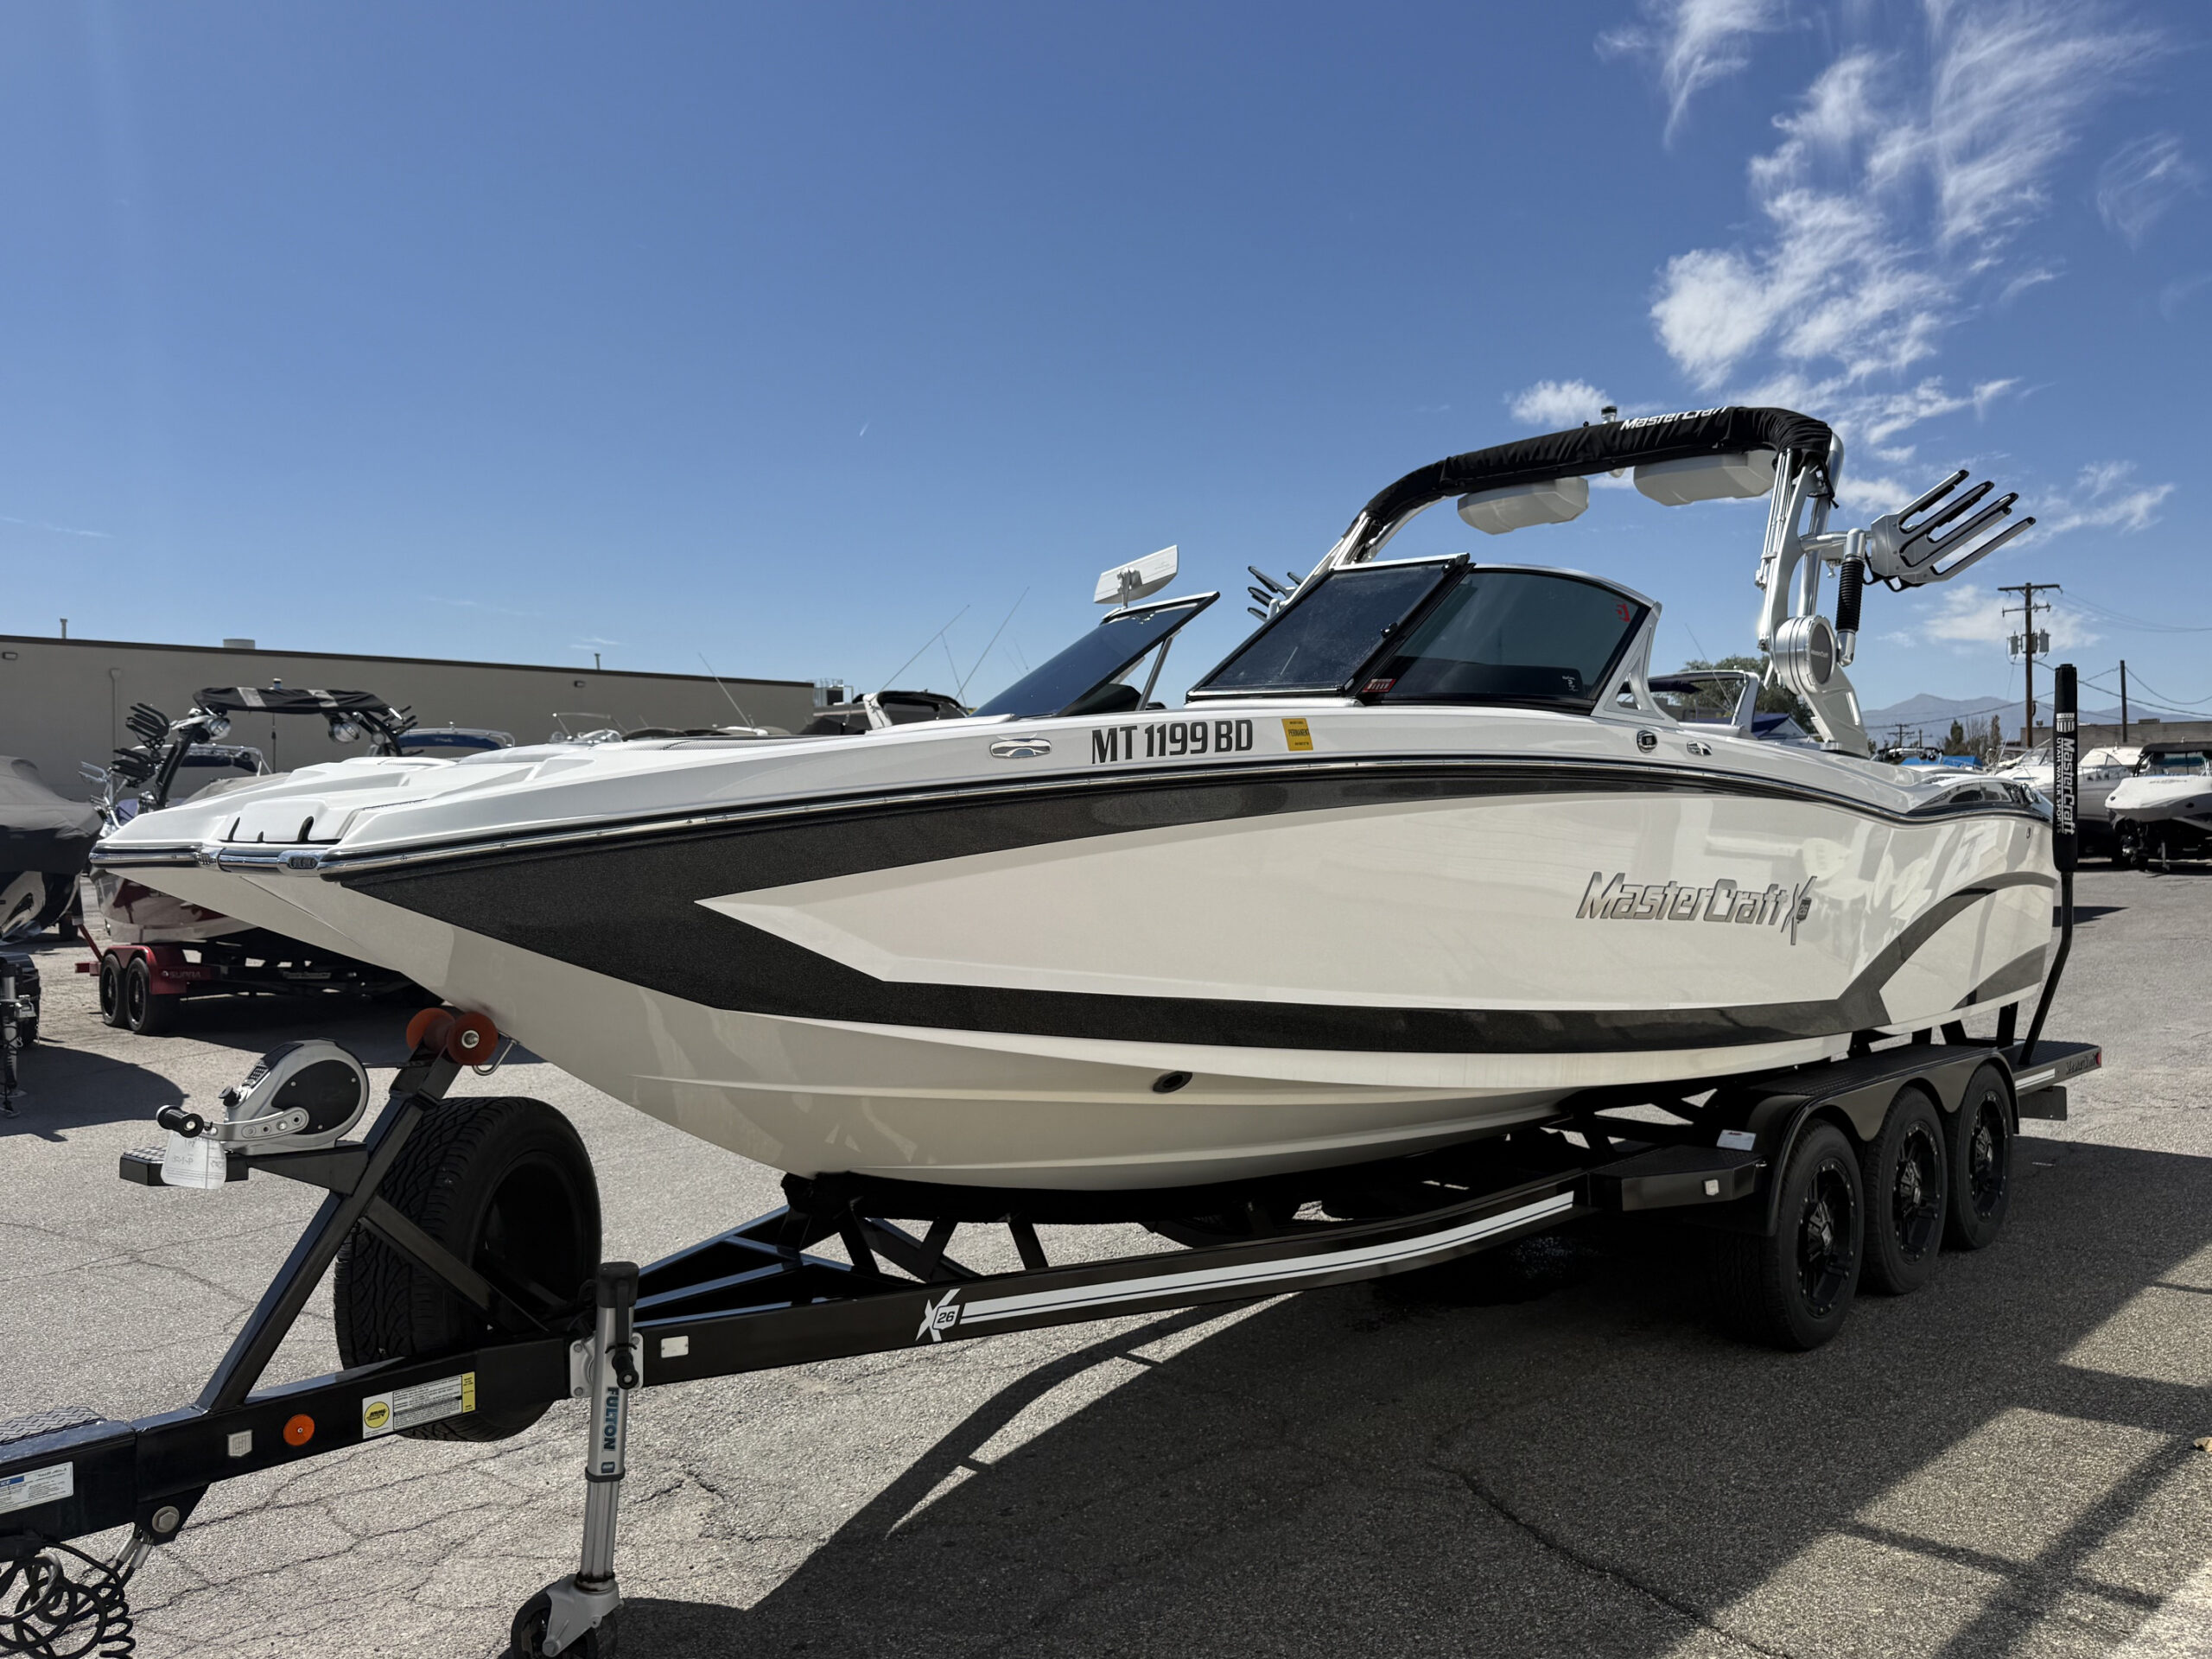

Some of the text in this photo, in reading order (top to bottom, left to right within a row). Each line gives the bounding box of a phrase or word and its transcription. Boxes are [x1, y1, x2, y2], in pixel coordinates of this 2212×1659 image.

[1091, 719, 1253, 765] MT 1199 BD
[2063, 737, 2075, 835] MasterCraft
[1575, 871, 1789, 925] MasterCraft
[604, 1386, 620, 1452] FULTON
